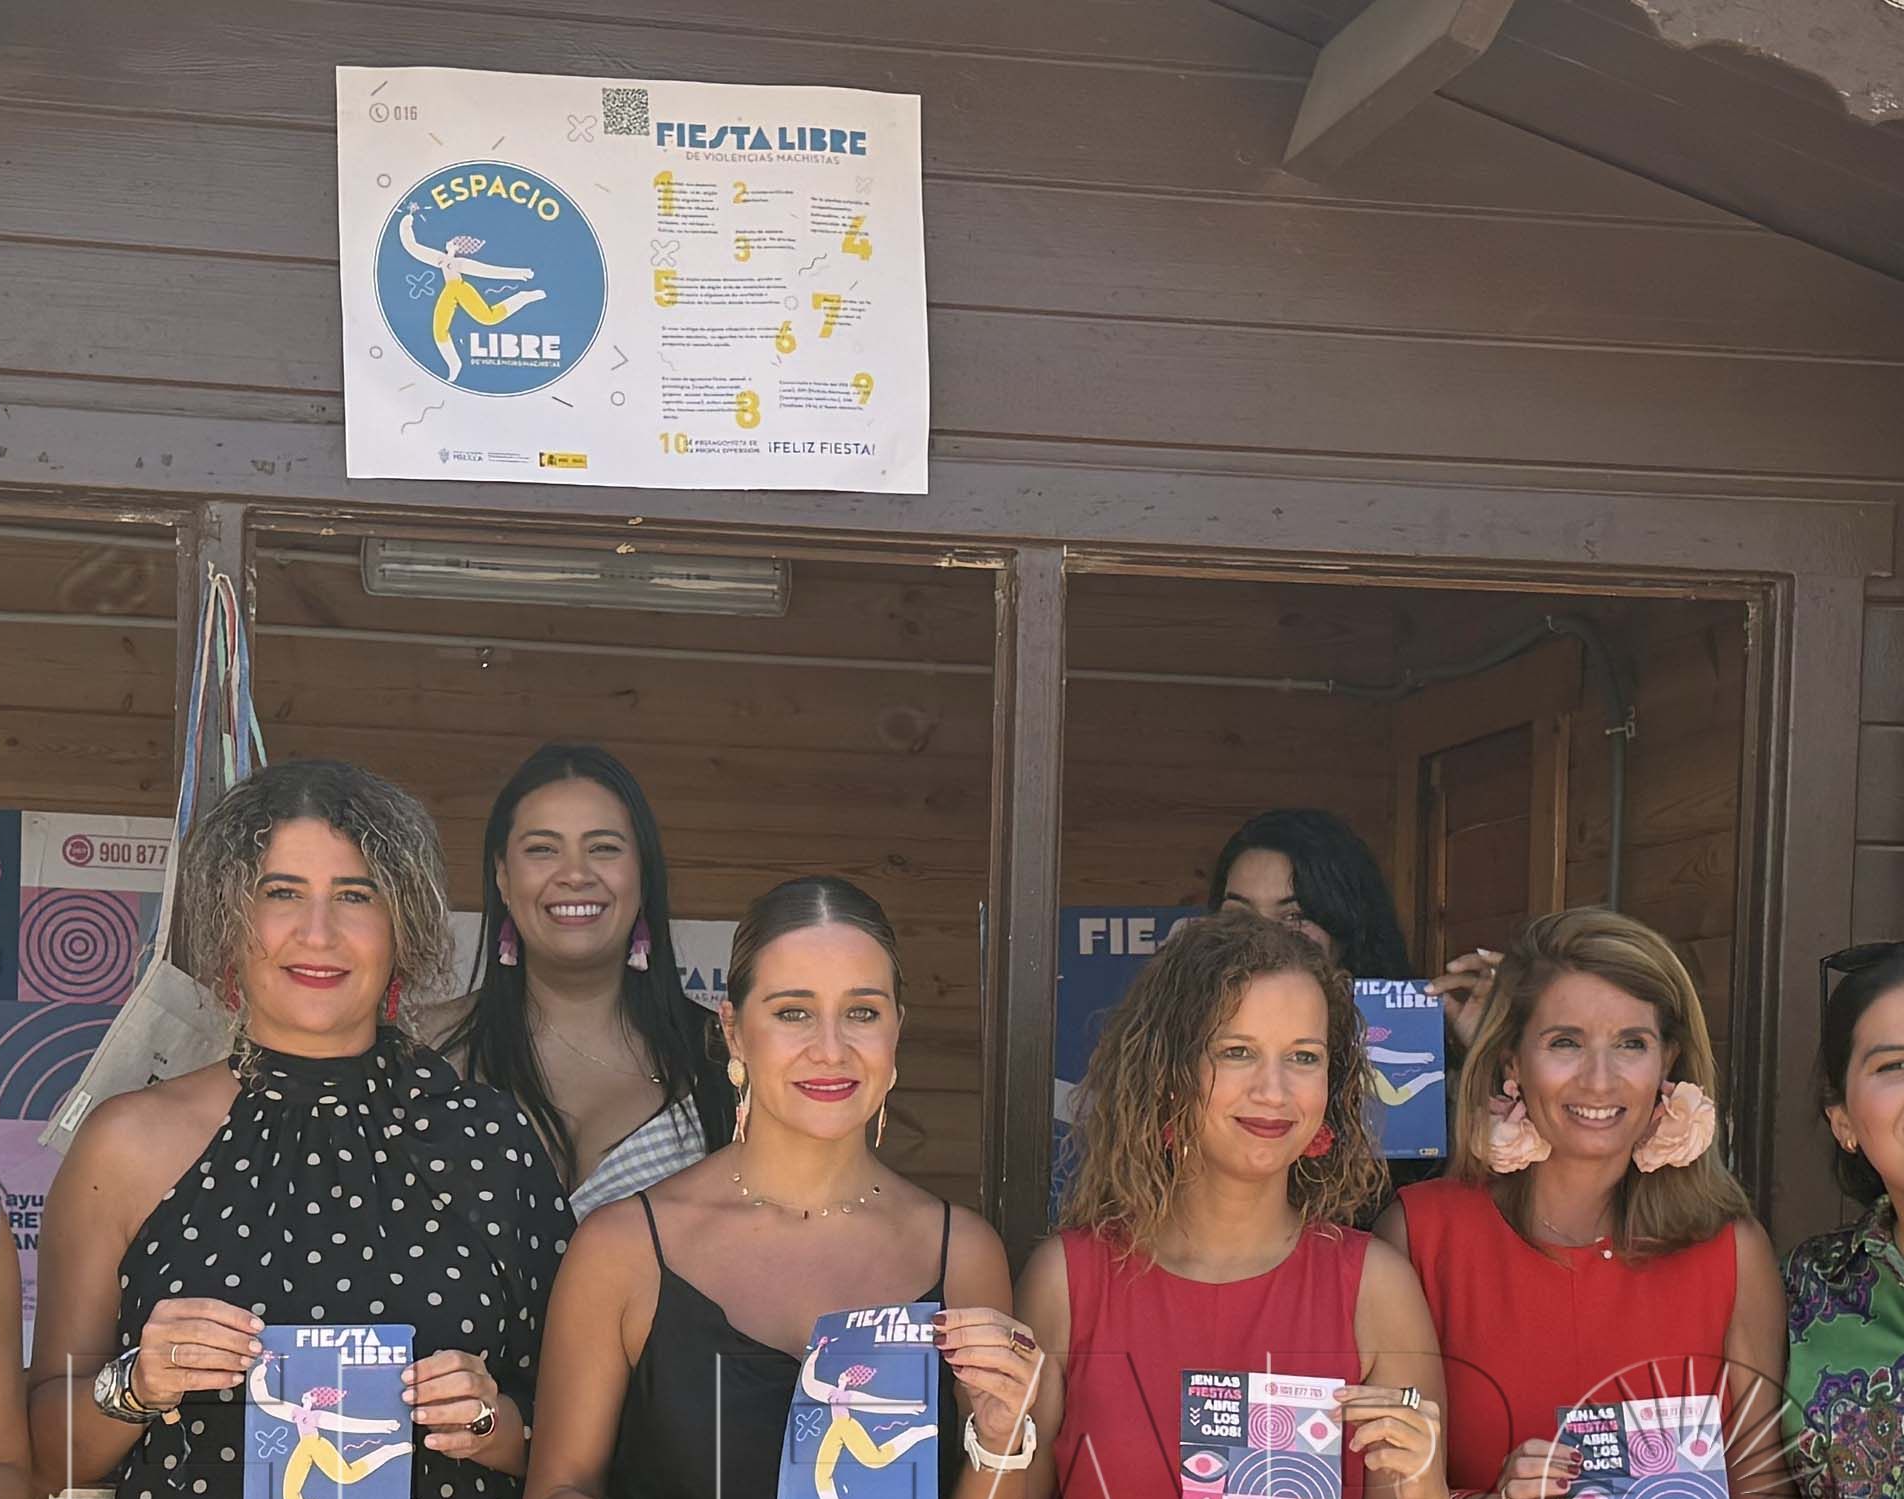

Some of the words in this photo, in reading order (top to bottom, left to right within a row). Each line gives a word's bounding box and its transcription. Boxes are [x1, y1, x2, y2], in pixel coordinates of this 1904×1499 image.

[394, 106, 417, 121] 016
[656, 122, 772, 150] FIESTA
[778, 127, 866, 156] LIBRE
[686, 151, 700, 161] DE
[705, 152, 774, 163] VIOLENCIAS
[776, 153, 840, 165] MACHISTAS
[431, 174, 560, 221] ESPACIO
[469, 332, 561, 359] LIBRE
[768, 441, 815, 454] ¡FELIZ
[820, 441, 875, 456] FIESTA!
[100, 842, 131, 862] 900
[137, 844, 169, 864] 877
[1385, 993, 1438, 1008] LIBRE
[846, 1307, 910, 1328] FIESTA
[296, 1328, 381, 1347] FIESTA
[874, 1324, 935, 1343] LIBRE
[341, 1346, 407, 1365] LIBRE
[1214, 1375, 1241, 1388] LAS
[1188, 1386, 1242, 1400] FIESTAS
[1204, 1399, 1240, 1412] ABRE
[1213, 1412, 1240, 1425] LOS
[1589, 1407, 1615, 1420] LAS
[1201, 1424, 1242, 1438] OJOS!
[1582, 1432, 1618, 1446] ABRE
